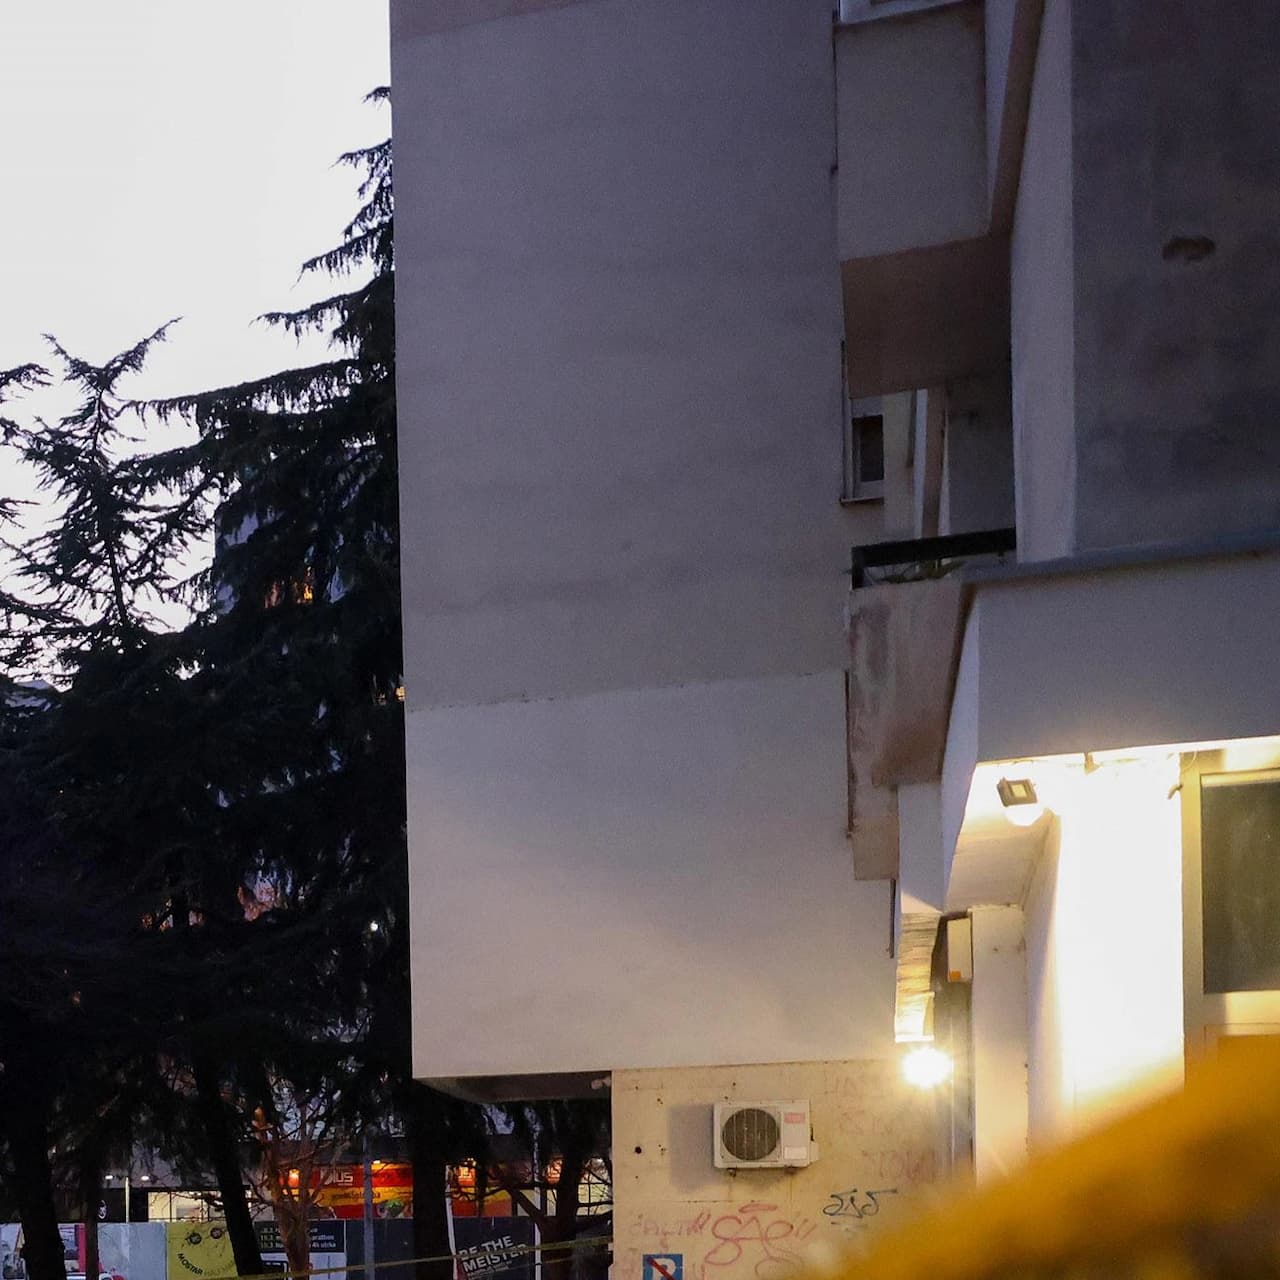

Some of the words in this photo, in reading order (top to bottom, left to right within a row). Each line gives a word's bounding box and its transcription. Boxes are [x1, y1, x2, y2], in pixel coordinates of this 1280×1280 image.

[481, 1235, 514, 1253] THE
[177, 1253, 203, 1275] MOSTAR
[462, 1243, 531, 1273] MEISTER
